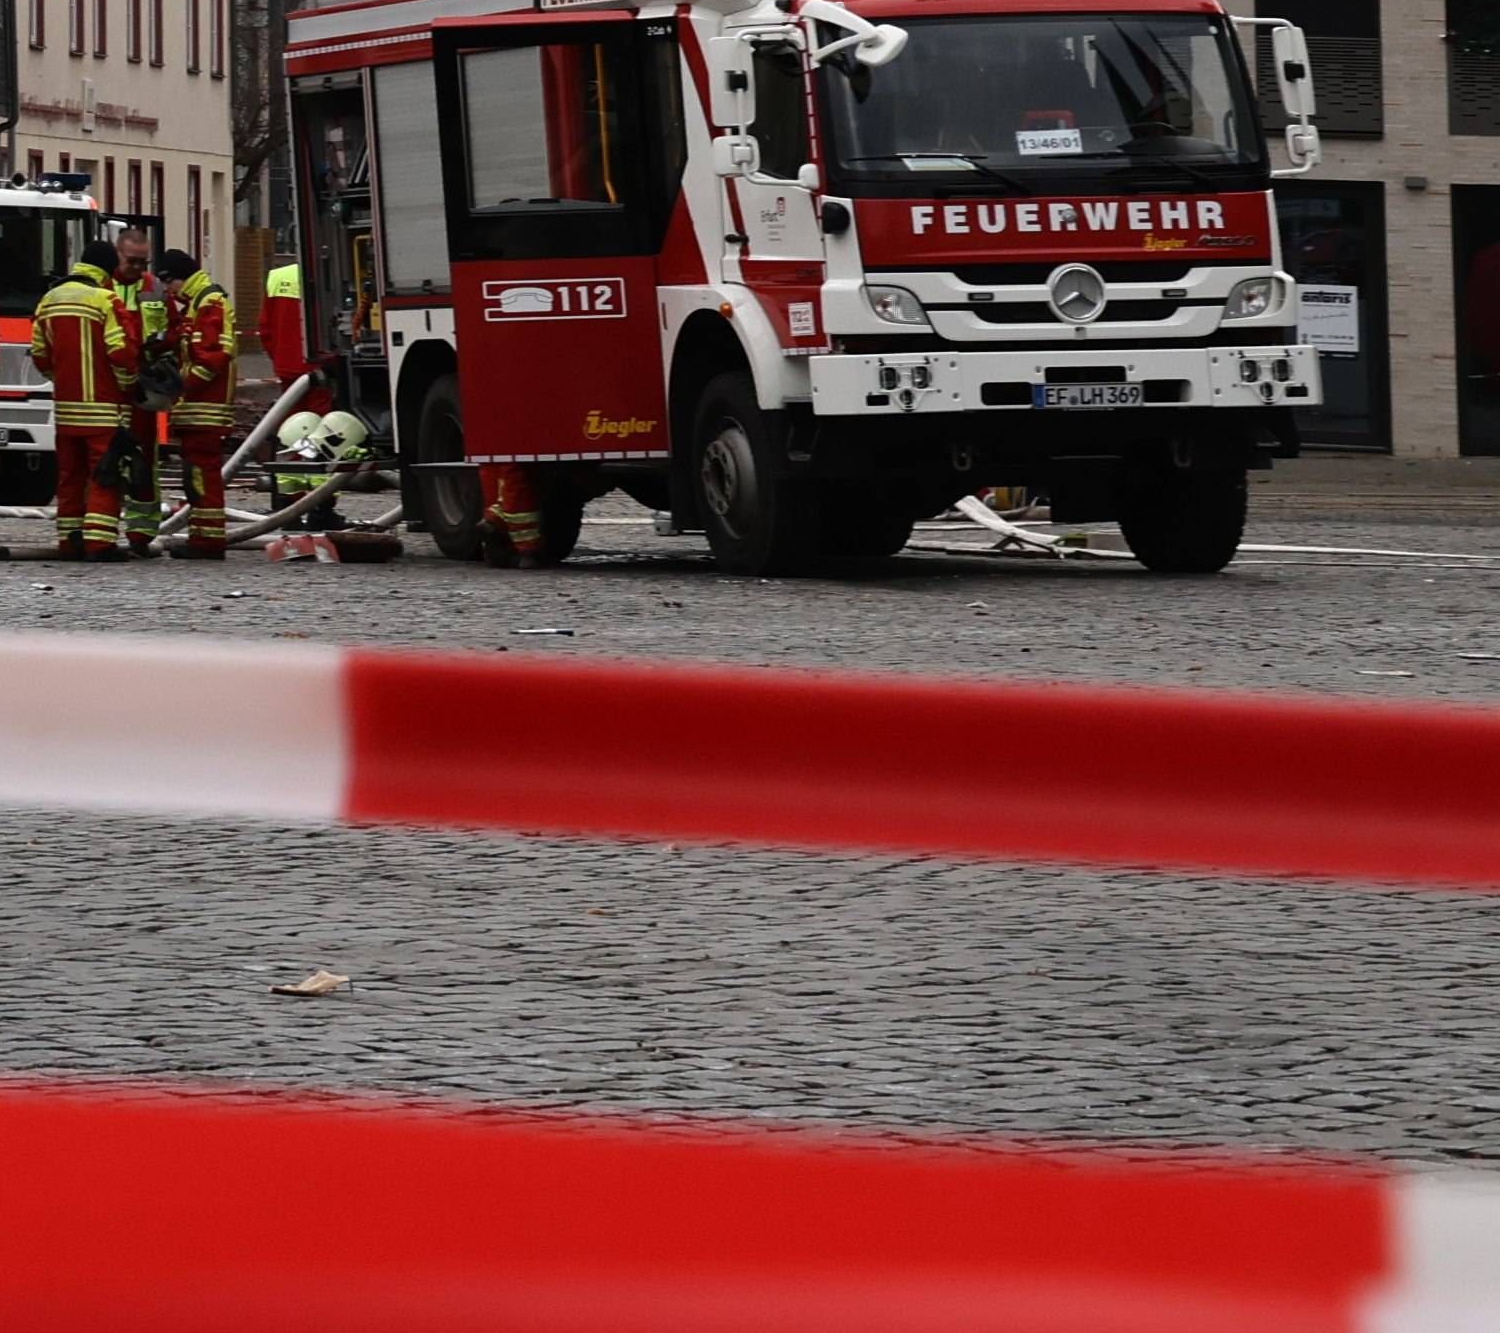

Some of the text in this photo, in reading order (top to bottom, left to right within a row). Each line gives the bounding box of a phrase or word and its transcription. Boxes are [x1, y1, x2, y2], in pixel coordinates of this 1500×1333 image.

[1019, 137, 1080, 150] 13/46/01
[910, 200, 1225, 234] FEUERWEHR
[557, 285, 613, 312] 112
[1046, 386, 1140, 405] EF LH 369
[584, 410, 656, 439] Ziegler
